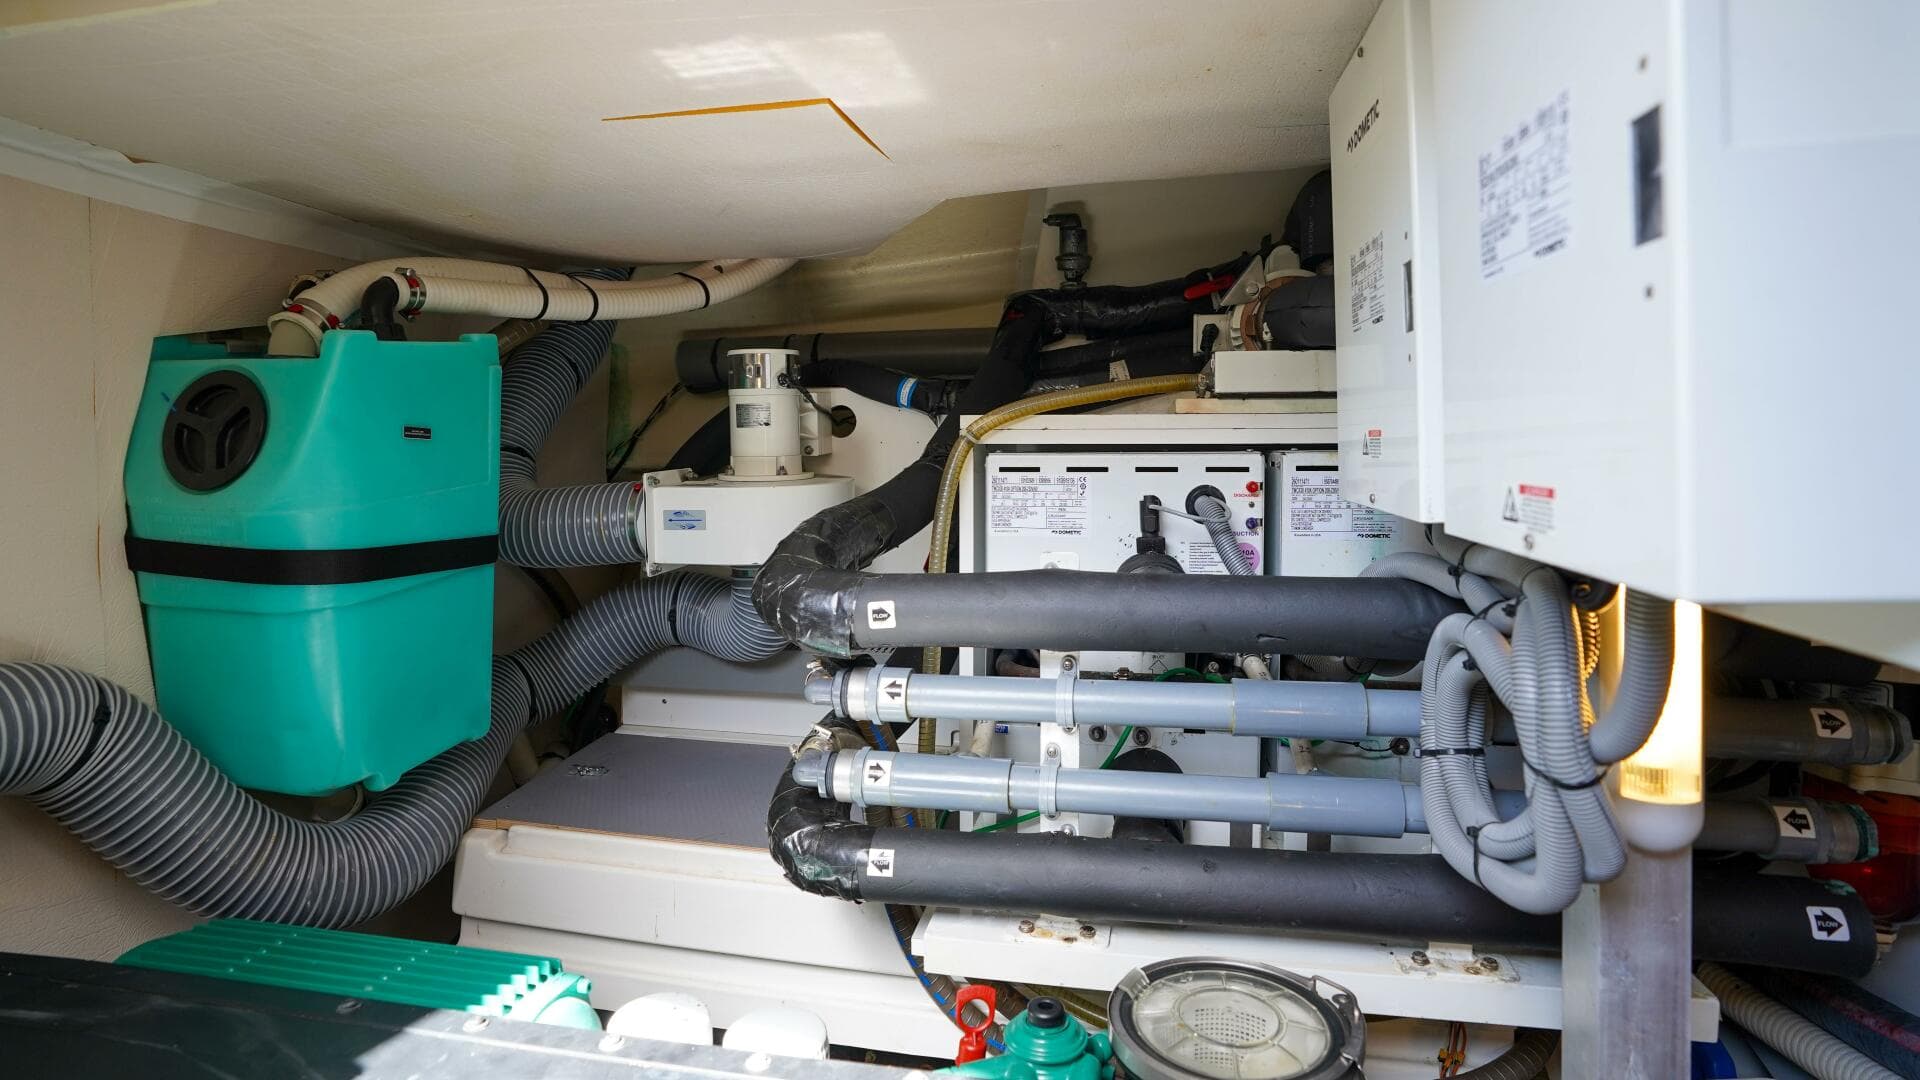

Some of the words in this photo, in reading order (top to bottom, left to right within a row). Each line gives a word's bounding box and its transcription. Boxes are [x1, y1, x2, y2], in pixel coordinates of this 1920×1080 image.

[1353, 98, 1380, 149] DOMETIC
[1821, 719, 1841, 727] FLOW
[1787, 816, 1807, 825] FLOW
[1817, 919, 1839, 928] FLOW
